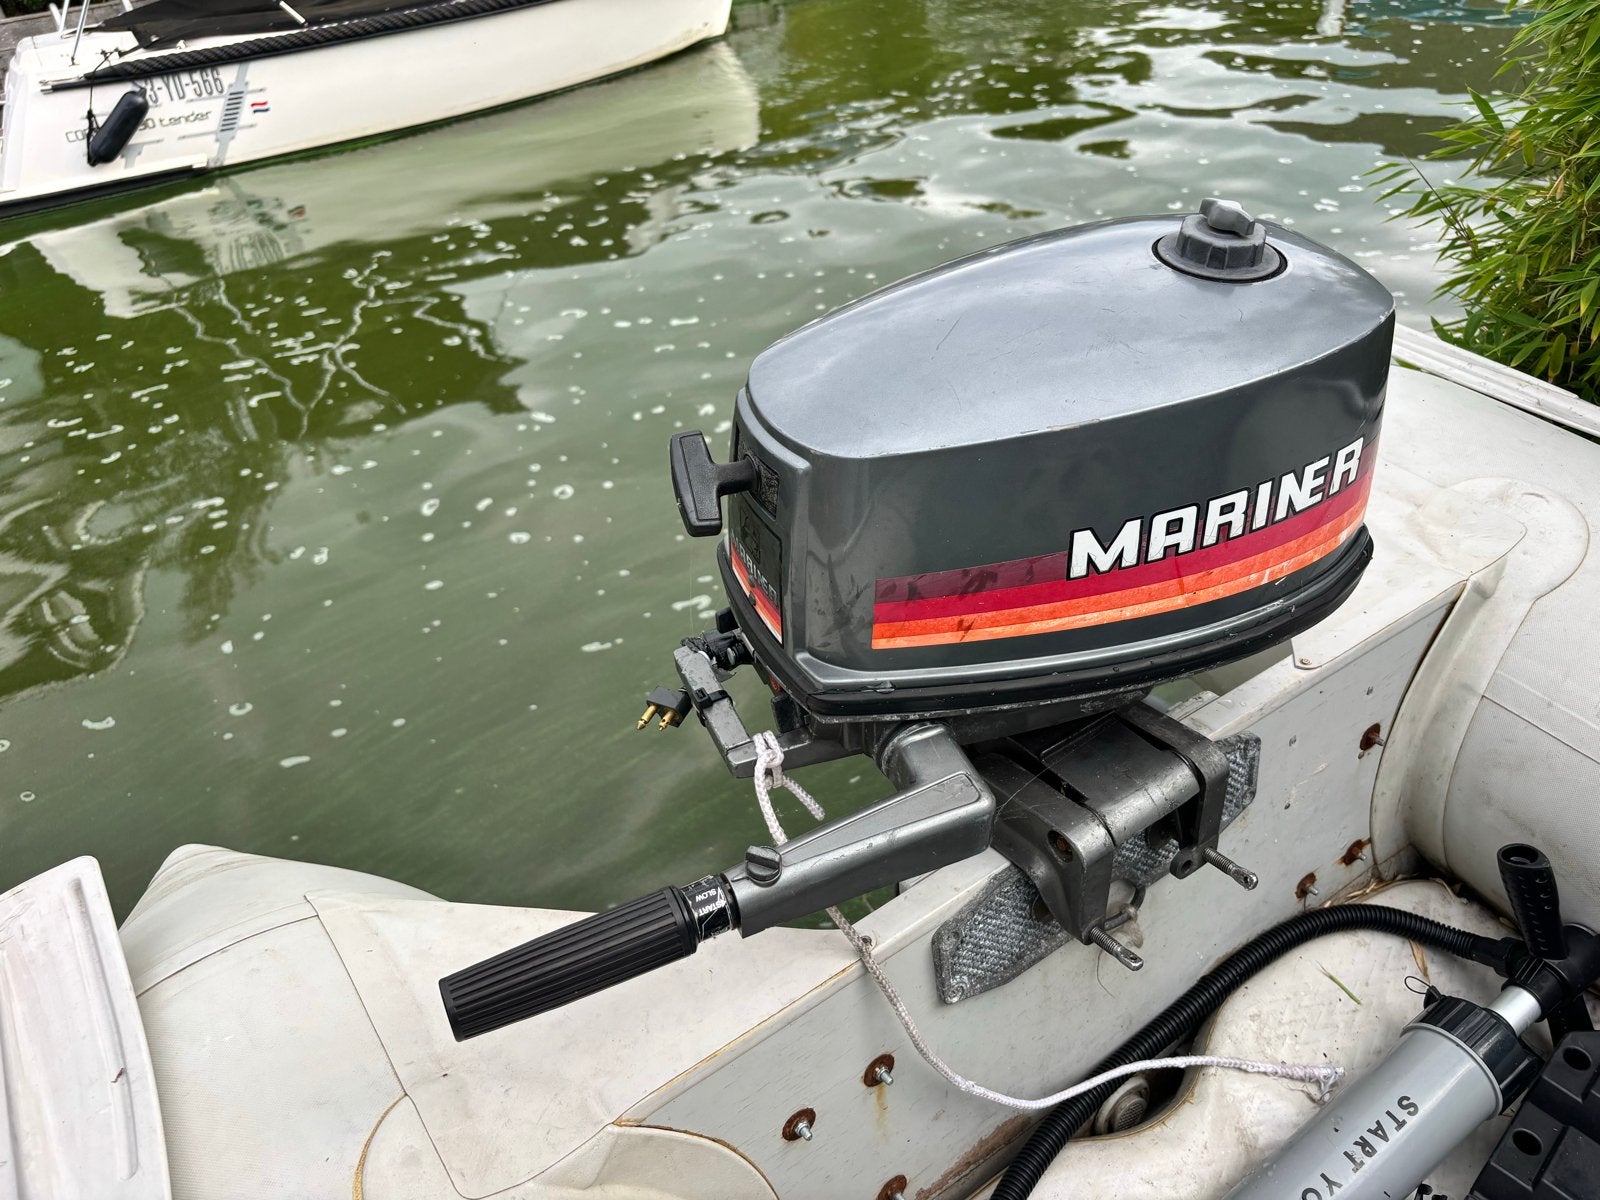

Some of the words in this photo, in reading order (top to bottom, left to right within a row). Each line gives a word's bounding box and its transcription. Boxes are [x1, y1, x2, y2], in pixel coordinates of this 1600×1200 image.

[159, 110, 212, 127] tender
[1067, 435, 1365, 581] MARINER
[696, 889, 716, 901] SLOW
[699, 901, 721, 916] START
[1343, 1095, 1419, 1173] START
